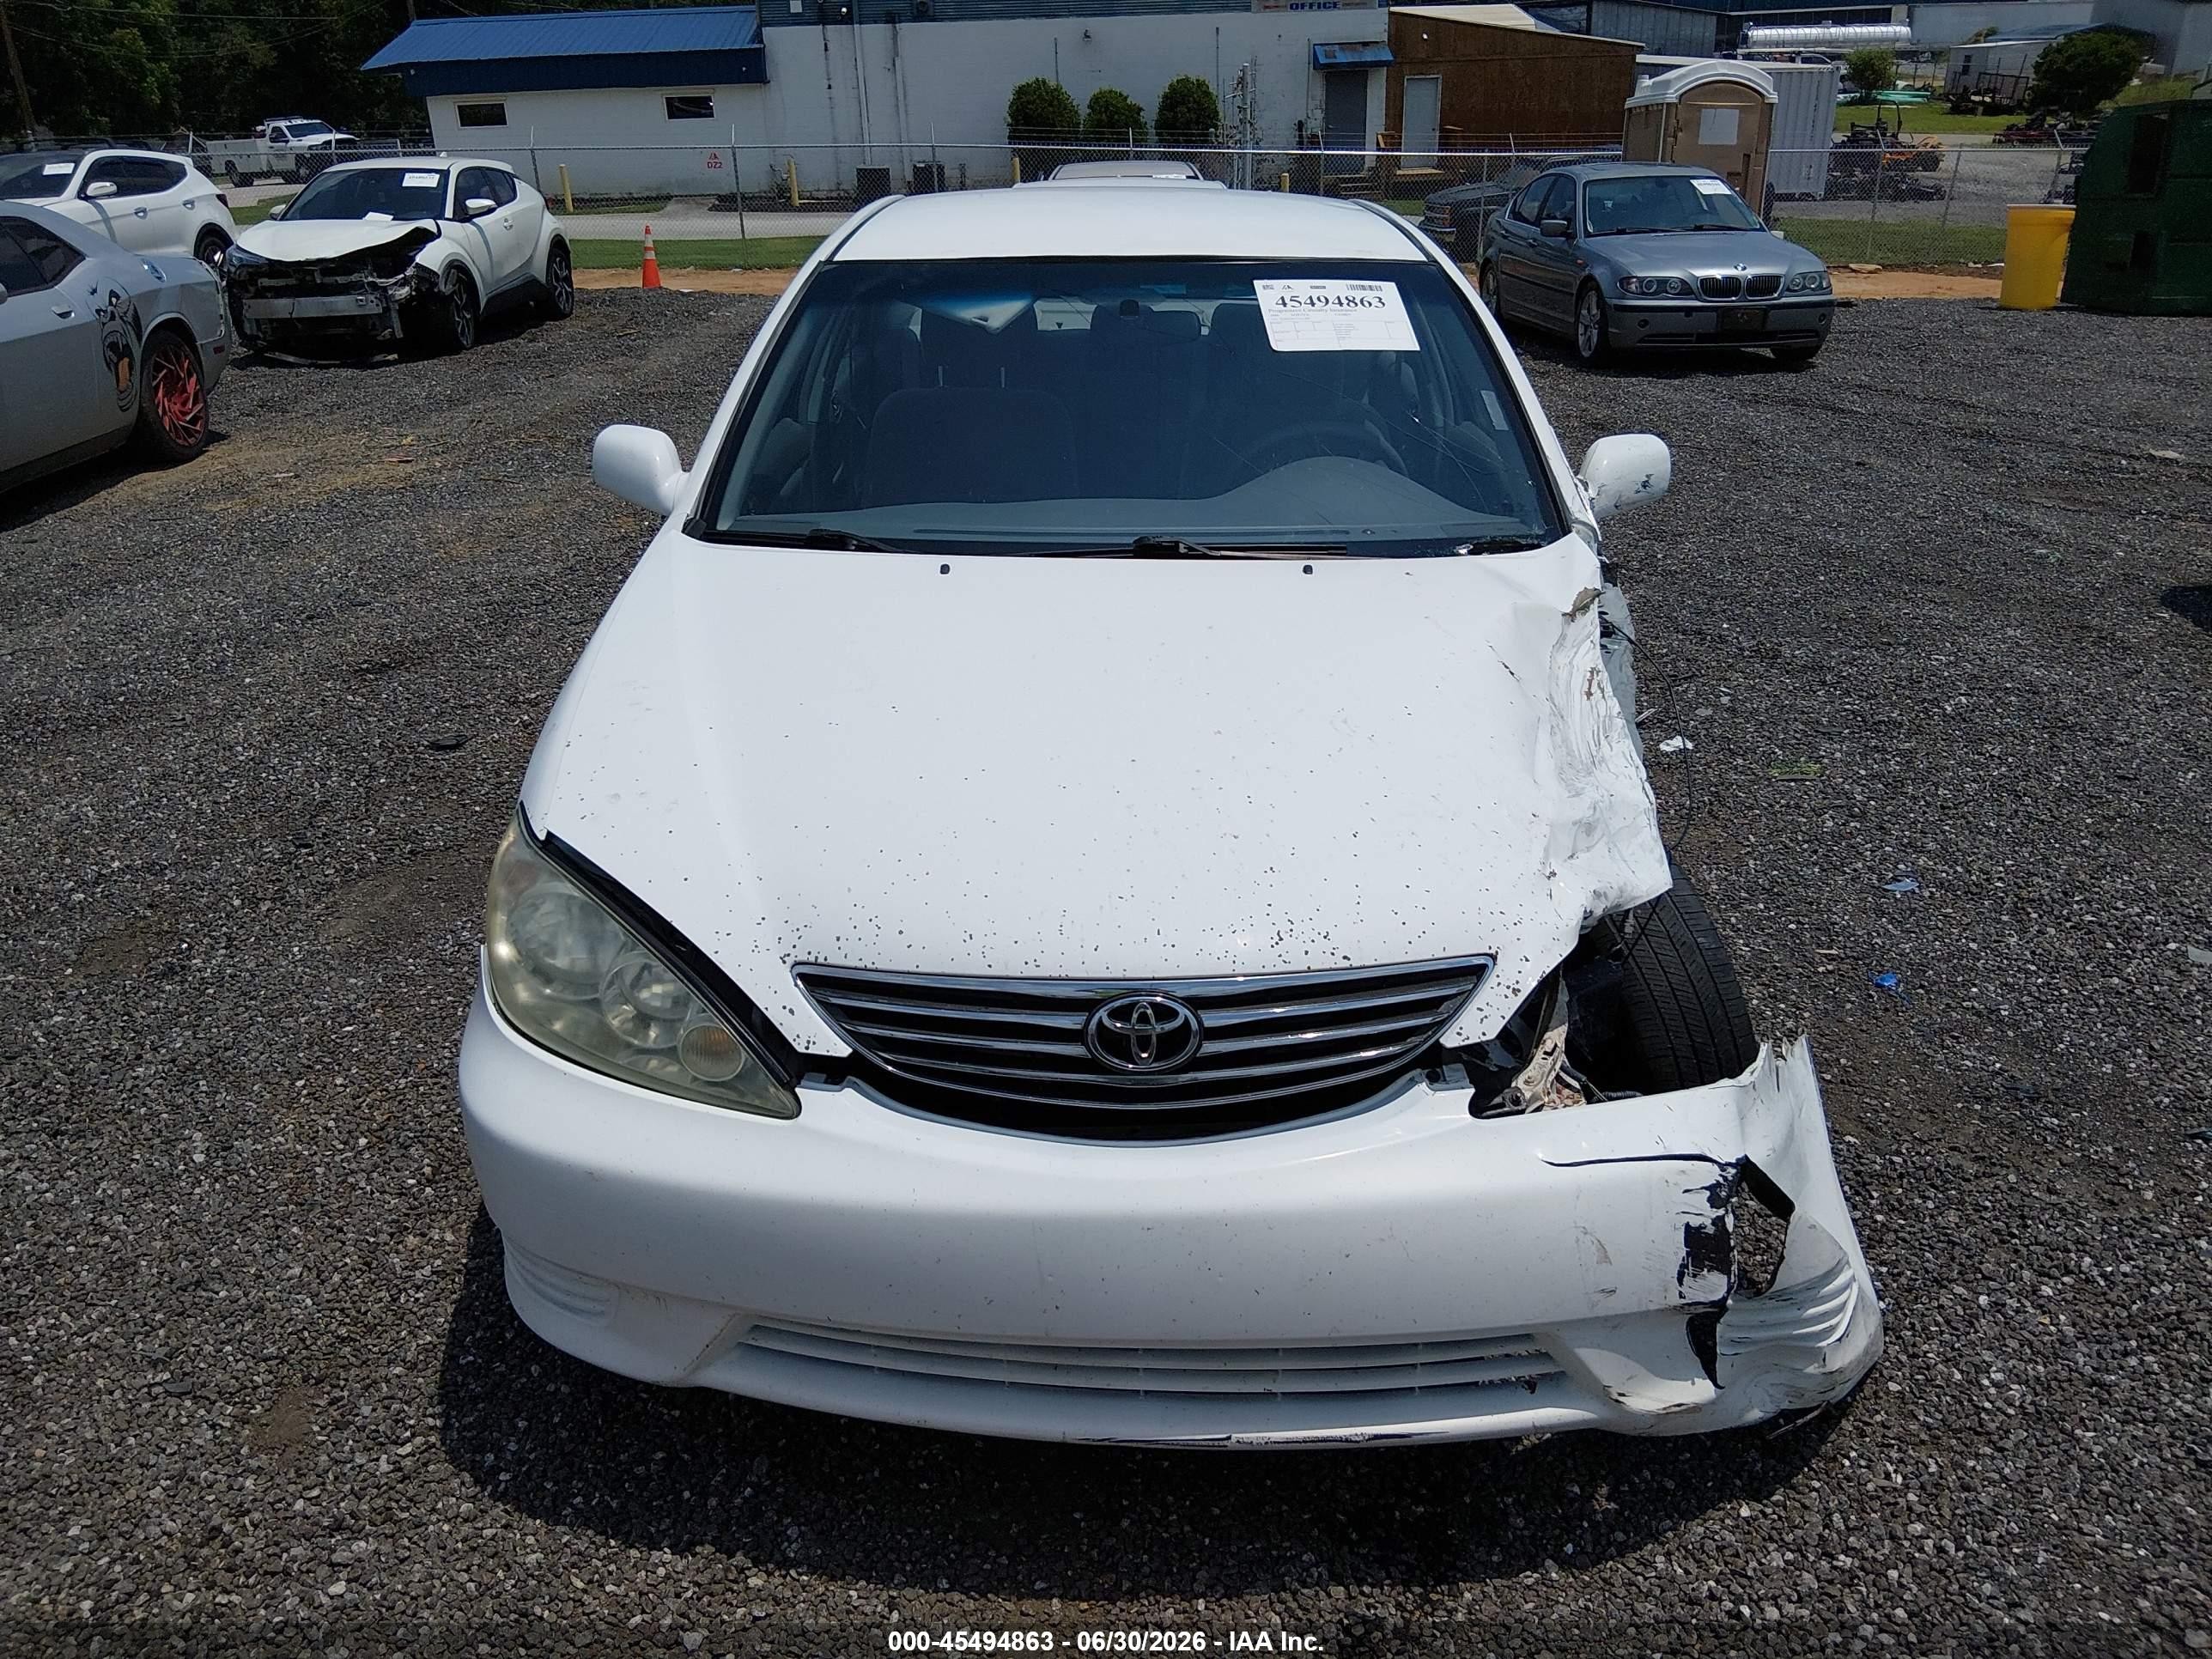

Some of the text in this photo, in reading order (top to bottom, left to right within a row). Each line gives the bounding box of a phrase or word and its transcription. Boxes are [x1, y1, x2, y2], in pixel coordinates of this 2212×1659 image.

[1289, 1, 1341, 10] OFFICE
[707, 161, 723, 169] DZ2
[1275, 295, 1386, 309] 45494863
